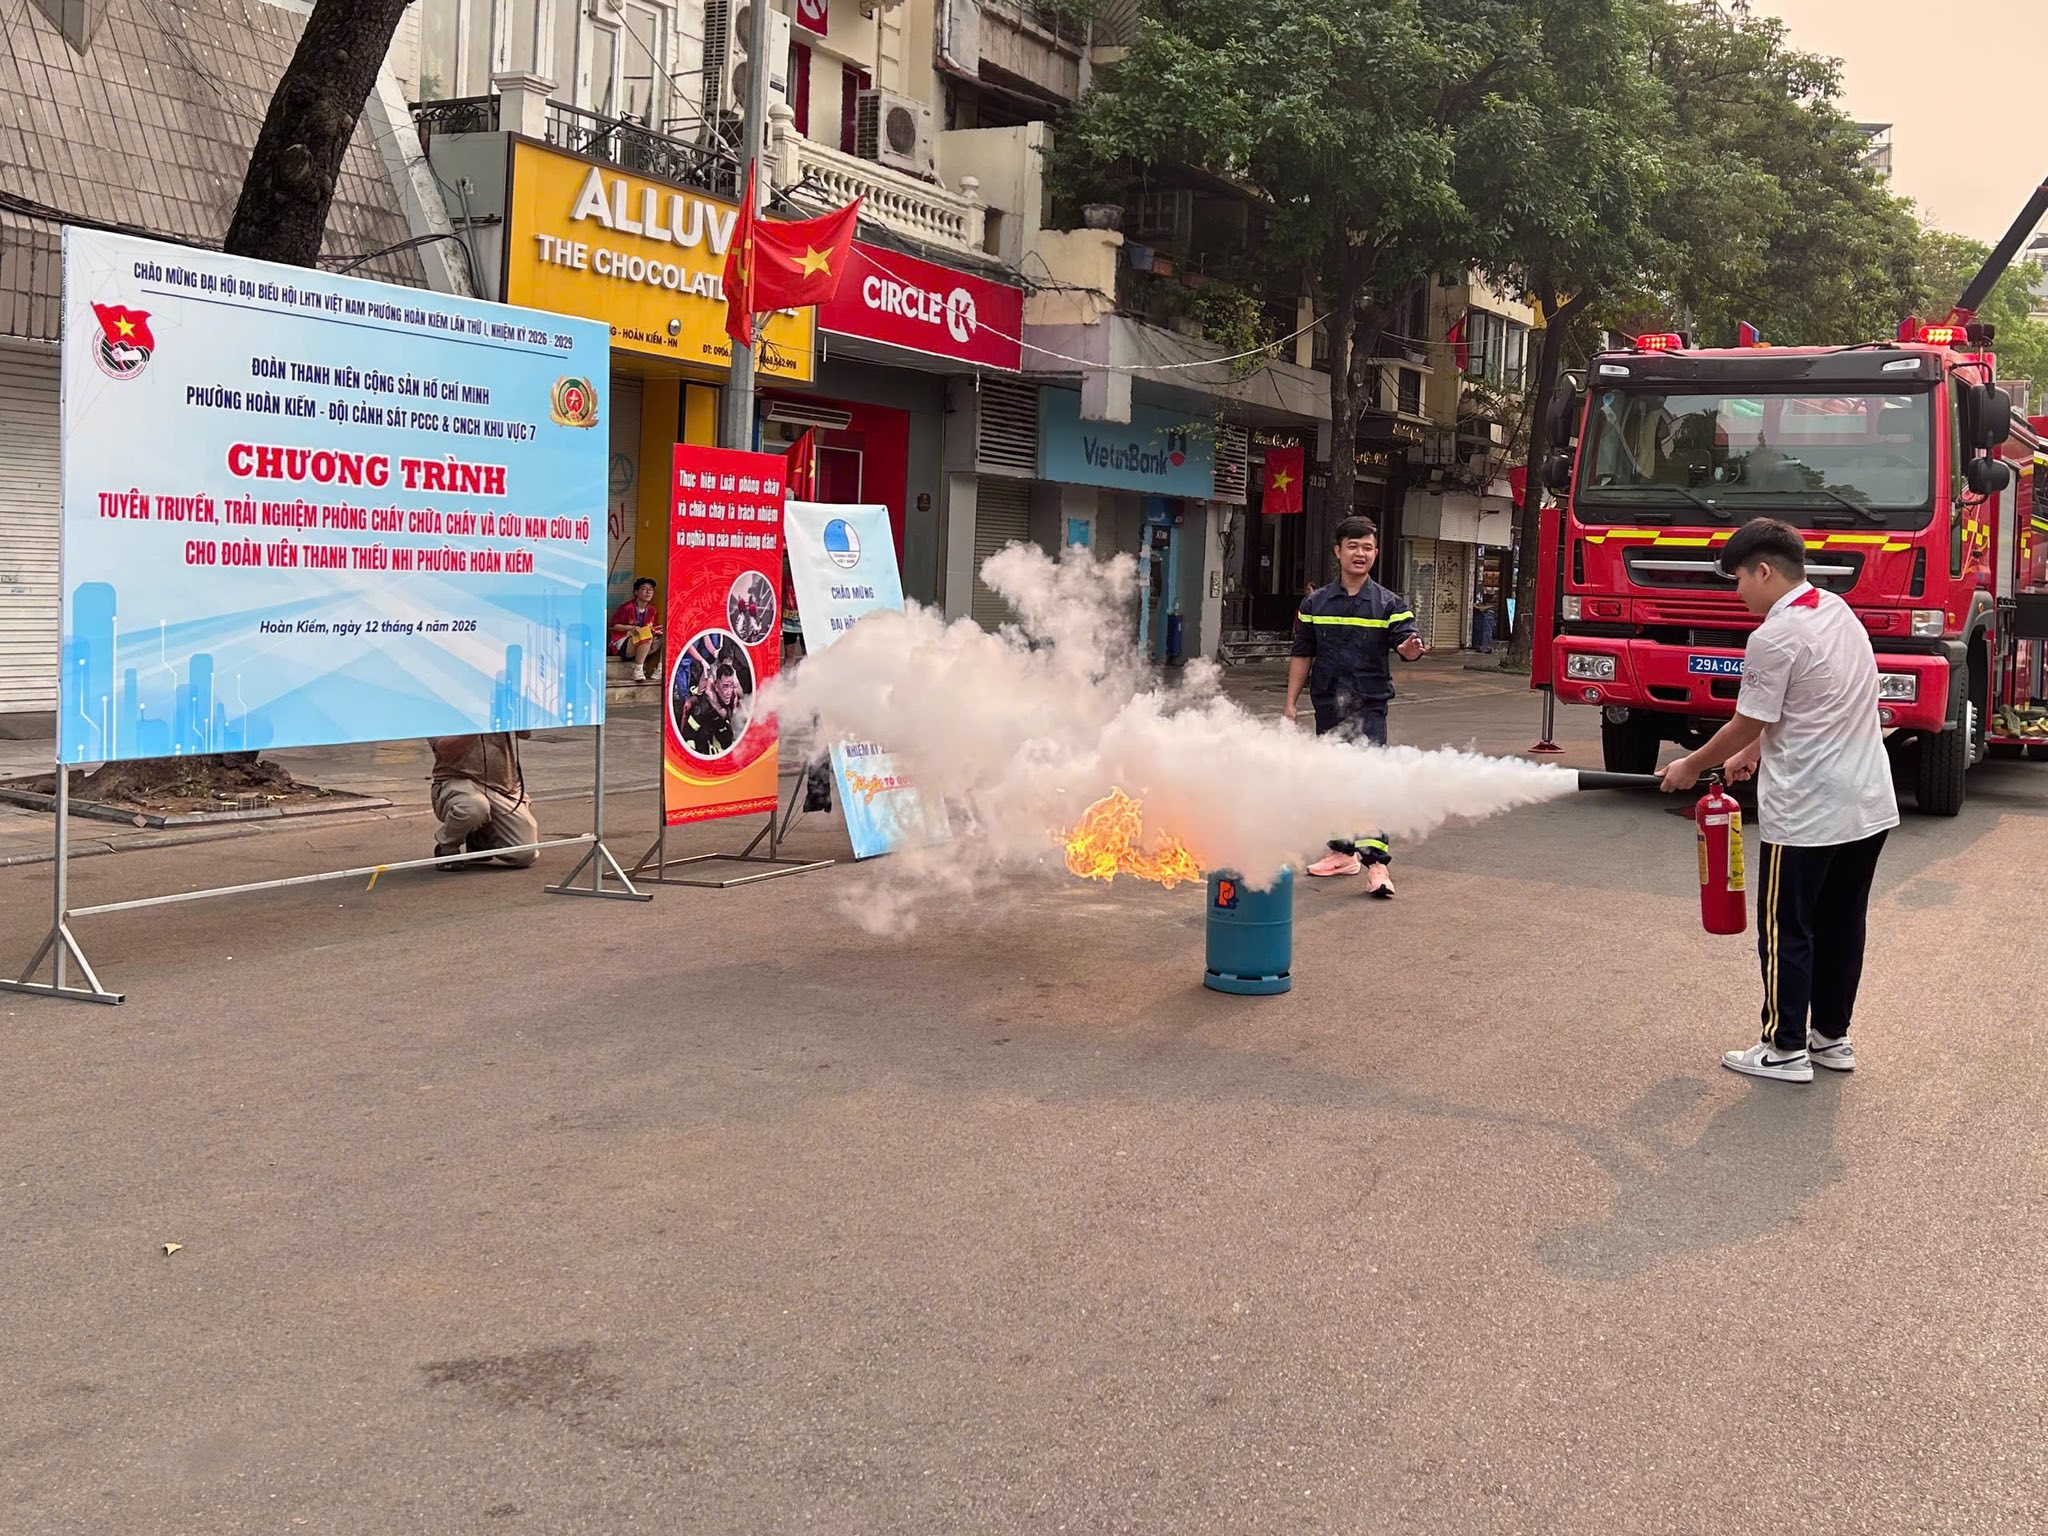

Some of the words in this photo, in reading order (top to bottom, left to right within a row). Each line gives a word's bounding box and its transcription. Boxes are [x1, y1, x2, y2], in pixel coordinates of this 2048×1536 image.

[570, 166, 738, 255] ALLUV
[535, 233, 588, 270] THE
[134, 261, 162, 282] CHÀO
[165, 266, 198, 288] MỪNG
[200, 273, 217, 294] ĐẠI
[220, 274, 237, 297] HỘI
[239, 279, 255, 300] ĐẠI
[282, 285, 297, 307] HỘI
[299, 291, 322, 310] LHTN
[324, 293, 343, 314] VIỆT
[345, 299, 365, 316] NAM
[368, 300, 402, 322] PHƯỜNG
[404, 306, 426, 326] HOÀN
[428, 309, 448, 330] KIẾM
[467, 318, 482, 335] THỨ
[491, 323, 515, 342] NHIỆM
[517, 323, 526, 342] KỲ
[528, 330, 548, 346] 2026
[554, 334, 573, 350] 2029
[863, 275, 942, 324] CIRCLE
[947, 287, 977, 342] K
[622, 327, 644, 342] HOÀN
[646, 331, 663, 345] KIẾM
[668, 338, 678, 348] HN
[251, 356, 286, 380] ĐOÀN
[290, 362, 330, 386] THANH
[334, 366, 360, 389] NIÊN
[364, 370, 394, 395] CỘNG
[398, 372, 419, 397] SẢN
[423, 378, 438, 399] HỒ
[441, 381, 459, 402] CHÍ
[462, 386, 490, 405] MINH
[186, 384, 242, 410] PHƯỜNG
[246, 391, 280, 415] HOÀN
[285, 395, 316, 418] KIẾM
[328, 400, 348, 425] ĐỘI
[352, 401, 383, 426] CẢNH
[387, 404, 407, 428] SÁT
[411, 412, 439, 431] PCCC
[442, 416, 449, 433] &
[453, 417, 480, 436] CNCH
[484, 420, 503, 438] KHU
[507, 423, 527, 443] VỰC
[530, 425, 537, 441] 7
[228, 443, 389, 486] CHƯƠNG
[401, 456, 506, 495] TRÌNH
[1084, 436, 1169, 475] VietinBank
[679, 470, 696, 491] Thực
[700, 472, 716, 493] hiện
[720, 474, 735, 494] Luật
[739, 476, 760, 495] phòng
[763, 478, 780, 496] cháy
[98, 488, 150, 520] TUYÊN
[155, 492, 219, 526] TRUYỀN,
[224, 494, 257, 525] TRẢI
[261, 499, 317, 532] NGHIỆM
[322, 502, 367, 530] PHÒNG
[371, 505, 405, 532] CHÁY
[409, 508, 442, 534] CHỮA
[446, 509, 477, 535] CHÁY
[481, 511, 494, 536] VÀ
[499, 512, 521, 537] CỨU
[525, 517, 547, 542] NẠN
[550, 515, 572, 539] CỨU
[575, 516, 589, 544] HỘ
[678, 499, 687, 516] và
[709, 502, 726, 520] cháy
[727, 503, 735, 519] là
[737, 504, 755, 520] trách
[757, 505, 778, 525] nhiệm
[185, 540, 216, 565] CHO
[221, 537, 262, 566] ĐOÀN
[267, 538, 298, 567] VIÊN
[302, 544, 347, 568] THANH
[352, 542, 387, 570] THIẾU
[392, 549, 412, 570] NHI
[417, 545, 466, 572] PHƯỜNG
[470, 546, 501, 572] HOÀN
[505, 549, 533, 573] KIẾM
[677, 529, 685, 546] và
[686, 529, 705, 548] nghĩa
[707, 533, 715, 551] vụ
[716, 529, 729, 547] của
[730, 529, 744, 548] mỗi
[744, 532, 761, 551] công
[831, 585, 851, 599] CHÀO
[852, 585, 875, 599] MỪNG
[259, 619, 293, 634] Hoàn
[296, 618, 329, 635] Kiếm,
[332, 620, 362, 636] ngày
[365, 621, 378, 633] 12
[381, 619, 413, 636] tháng
[416, 621, 423, 632] 4
[425, 620, 449, 632] năm
[451, 620, 477, 632] 2026
[830, 618, 844, 633] ĐẠI
